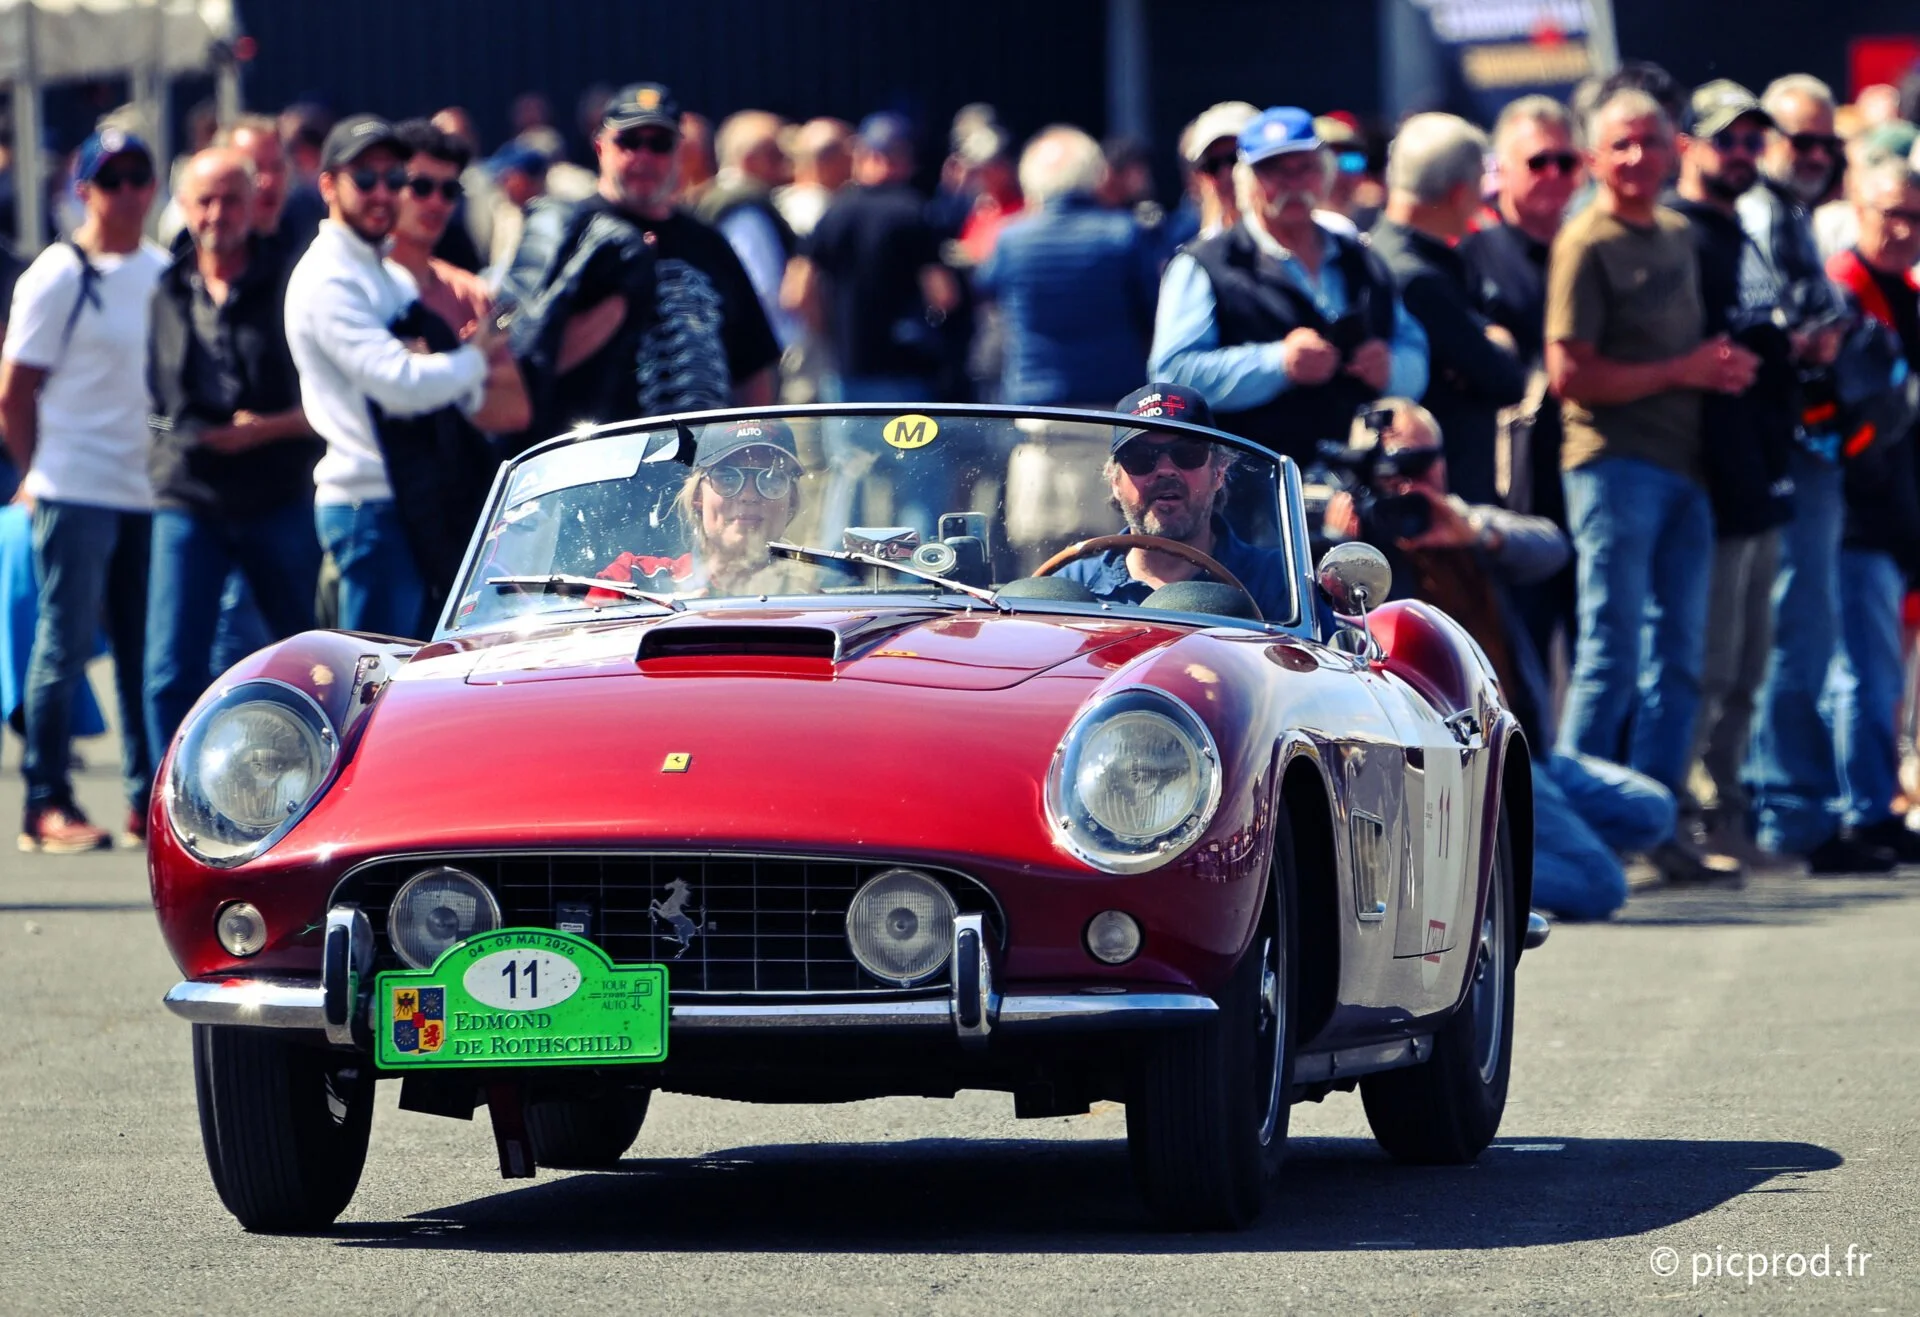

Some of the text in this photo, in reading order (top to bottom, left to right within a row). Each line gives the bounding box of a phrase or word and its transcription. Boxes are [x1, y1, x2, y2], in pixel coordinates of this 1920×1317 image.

[1137, 393, 1162, 408] TOUR
[1138, 406, 1163, 418] AUTO
[736, 427, 762, 438] AUTO
[893, 421, 927, 443] M
[469, 944, 485, 958] 04
[495, 935, 512, 948] 09
[516, 935, 541, 945] MAI
[544, 937, 576, 956] 2026
[501, 959, 538, 999] 11
[602, 980, 627, 990] TOUR
[601, 1000, 627, 1010] AUTO
[454, 1012, 552, 1031] EDMOND
[454, 1034, 634, 1056] DE ROTHSCHILD
